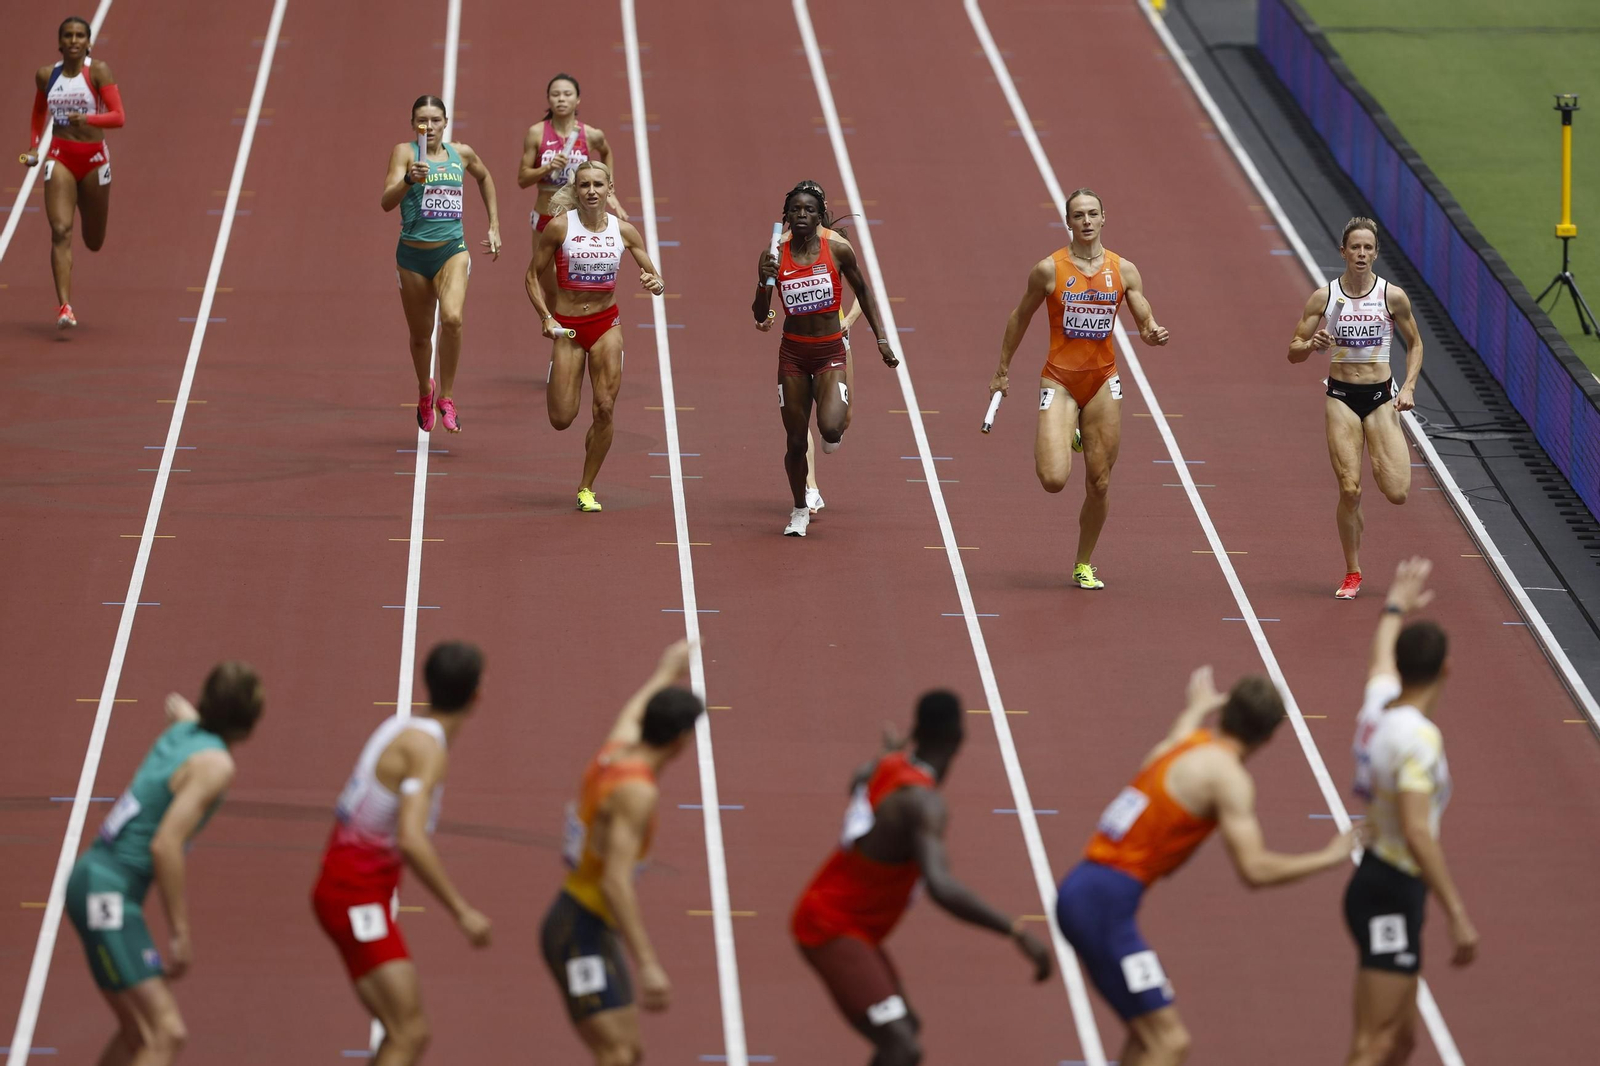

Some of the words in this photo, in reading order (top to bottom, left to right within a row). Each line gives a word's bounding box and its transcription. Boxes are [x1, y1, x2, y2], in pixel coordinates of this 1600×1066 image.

[425, 198, 461, 210] GROSS
[782, 278, 830, 291] HONDA
[786, 288, 830, 305] OKETCH
[1062, 290, 1117, 300] Nederland
[1066, 306, 1113, 314] HONDA
[1066, 316, 1110, 329] KLAVER
[1334, 326, 1381, 337] VERVAET
